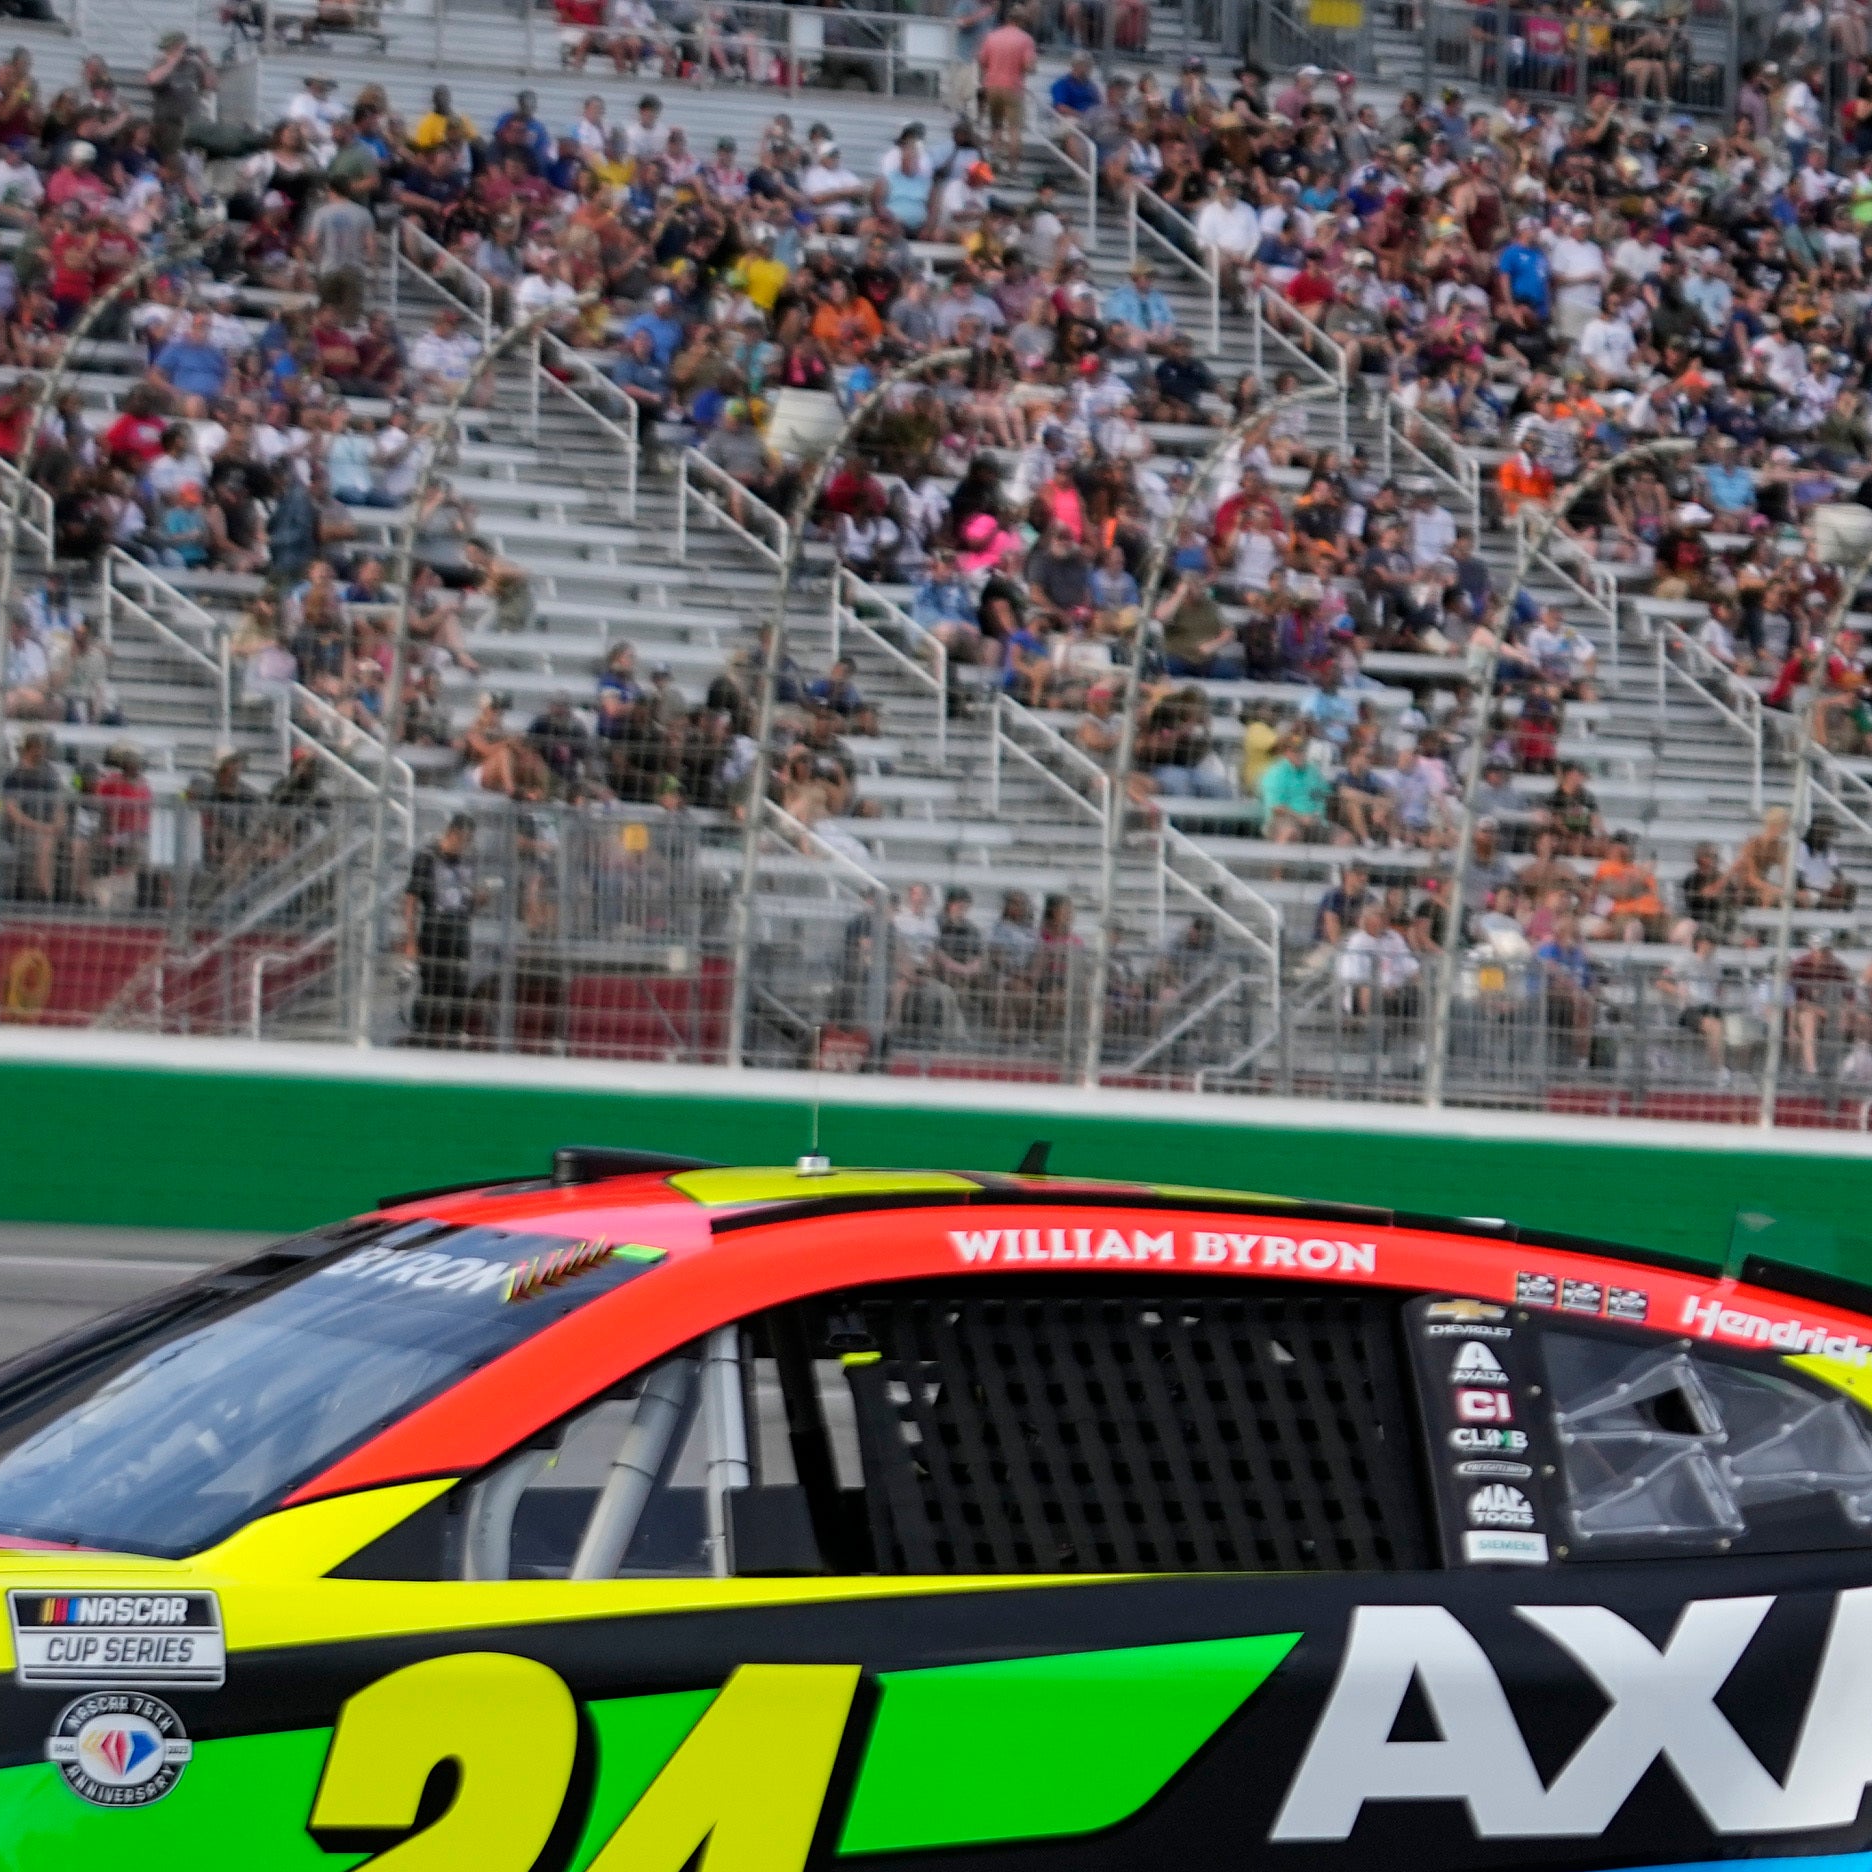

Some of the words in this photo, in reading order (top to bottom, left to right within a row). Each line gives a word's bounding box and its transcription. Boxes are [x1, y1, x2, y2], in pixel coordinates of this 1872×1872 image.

[949, 1228, 1176, 1263] WILLIAM
[1193, 1231, 1378, 1274] BYRON
[321, 1245, 514, 1294] BYRON
[1428, 1323, 1513, 1338] CHEVROLET
[1451, 1369, 1510, 1384] AXALTA
[1470, 1482, 1534, 1512] MAC
[1471, 1511, 1536, 1527] TOOLS
[78, 1596, 189, 1625] NASCAR
[46, 1636, 99, 1663] CUP
[102, 1636, 196, 1663] SERIES
[67, 1696, 129, 1729] NASCAR
[131, 1697, 175, 1734] 75TH
[63, 1763, 176, 1804] ANNIVERSARY
